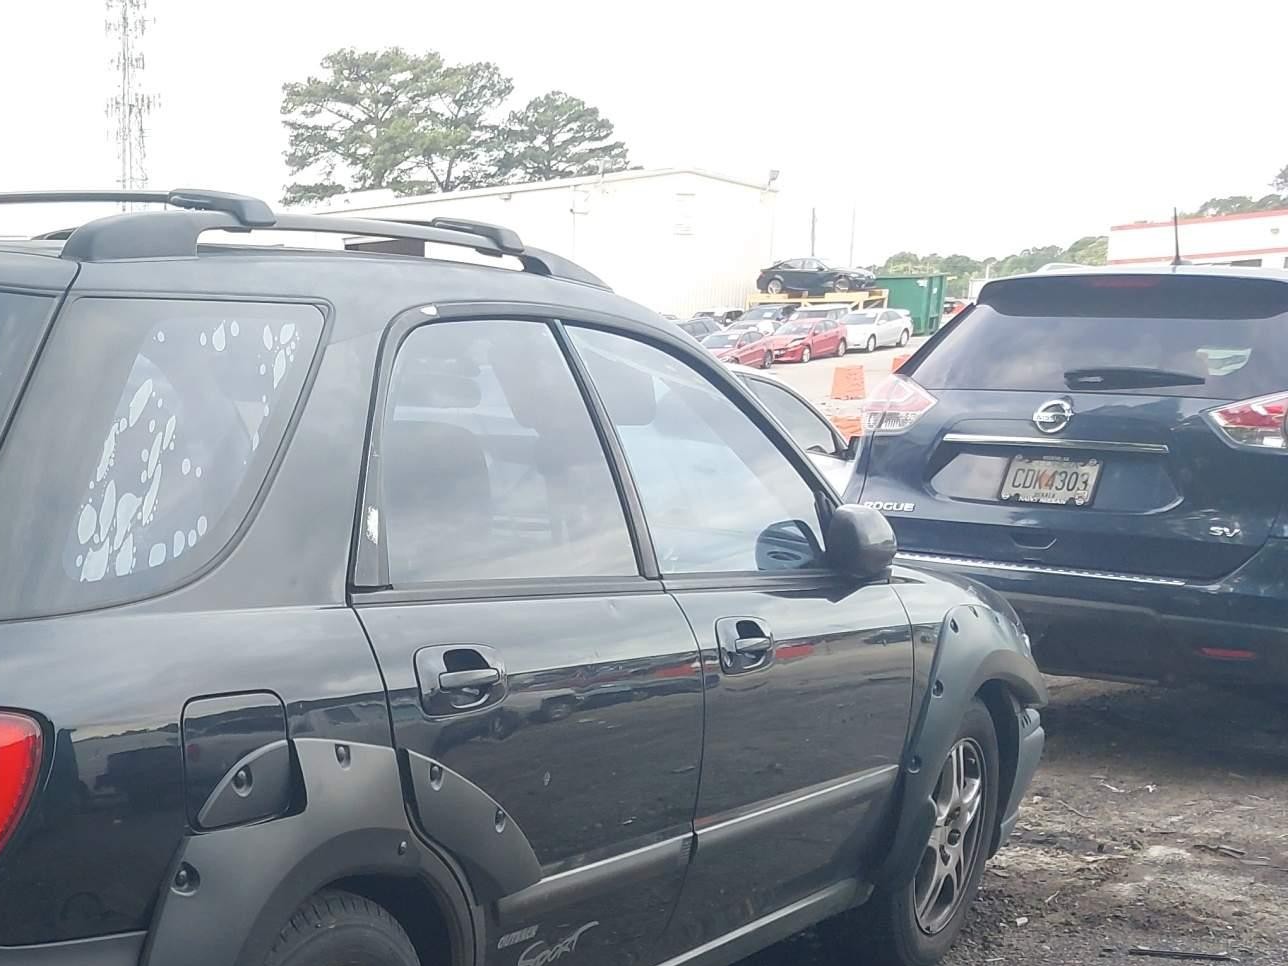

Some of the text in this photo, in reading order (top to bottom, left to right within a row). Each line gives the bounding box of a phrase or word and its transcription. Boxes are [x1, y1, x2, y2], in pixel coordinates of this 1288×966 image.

[1012, 467, 1091, 491] CDK4303
[864, 501, 915, 511] ROGUE
[1209, 526, 1241, 537] SV
